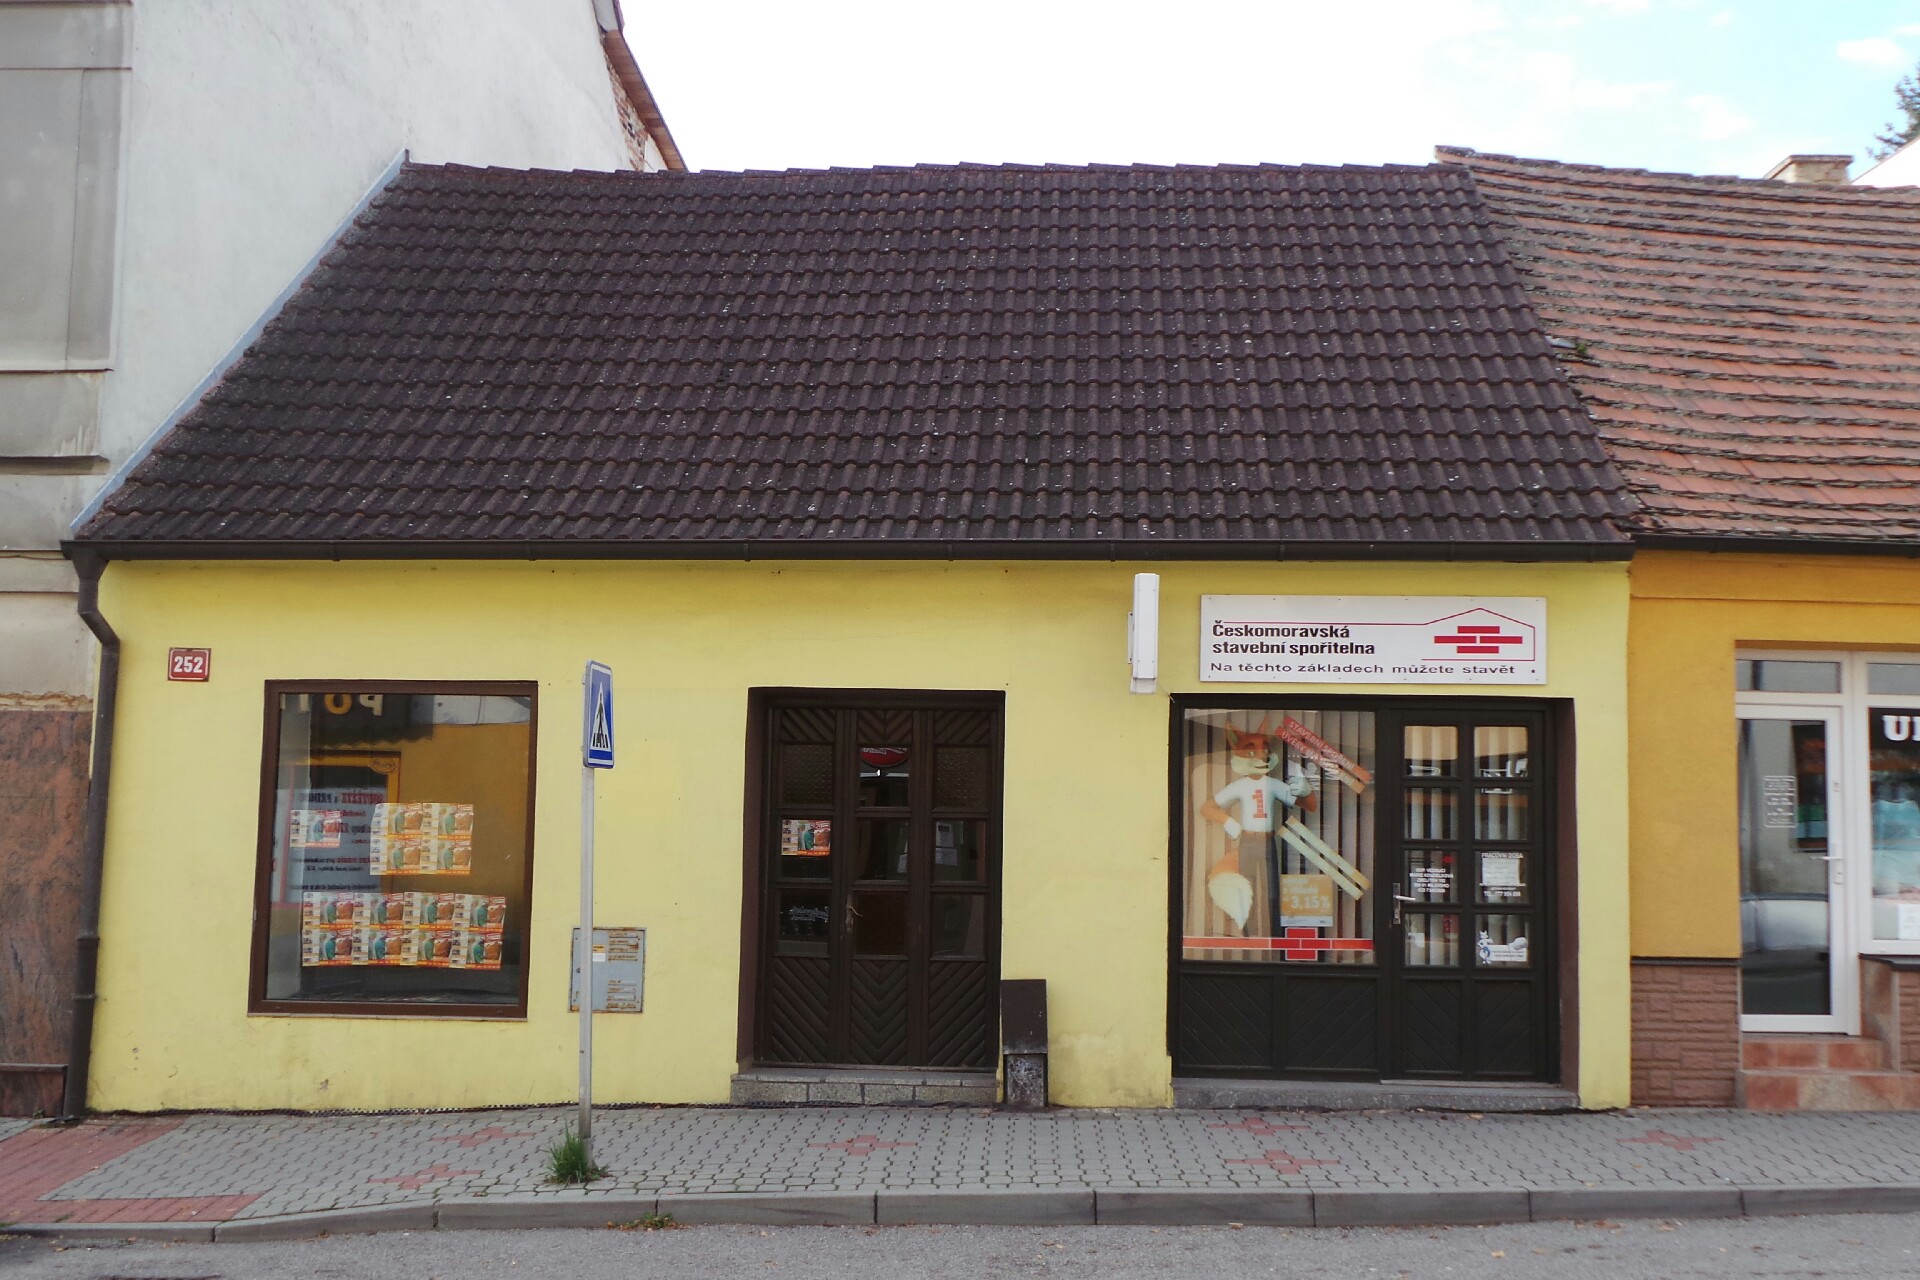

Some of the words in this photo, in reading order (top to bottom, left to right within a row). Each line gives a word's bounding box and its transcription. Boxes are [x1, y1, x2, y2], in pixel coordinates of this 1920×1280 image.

[1212, 619, 1350, 639] Českomoravská
[1212, 641, 1286, 655] stavební
[1289, 640, 1375, 656] spořitelna
[173, 656, 204, 673] 252
[1210, 662, 1233, 672] Na
[1238, 662, 1292, 673] těchto
[1297, 662, 1384, 674] základech
[1392, 662, 1454, 674] můžete
[1462, 663, 1515, 674] stavět
